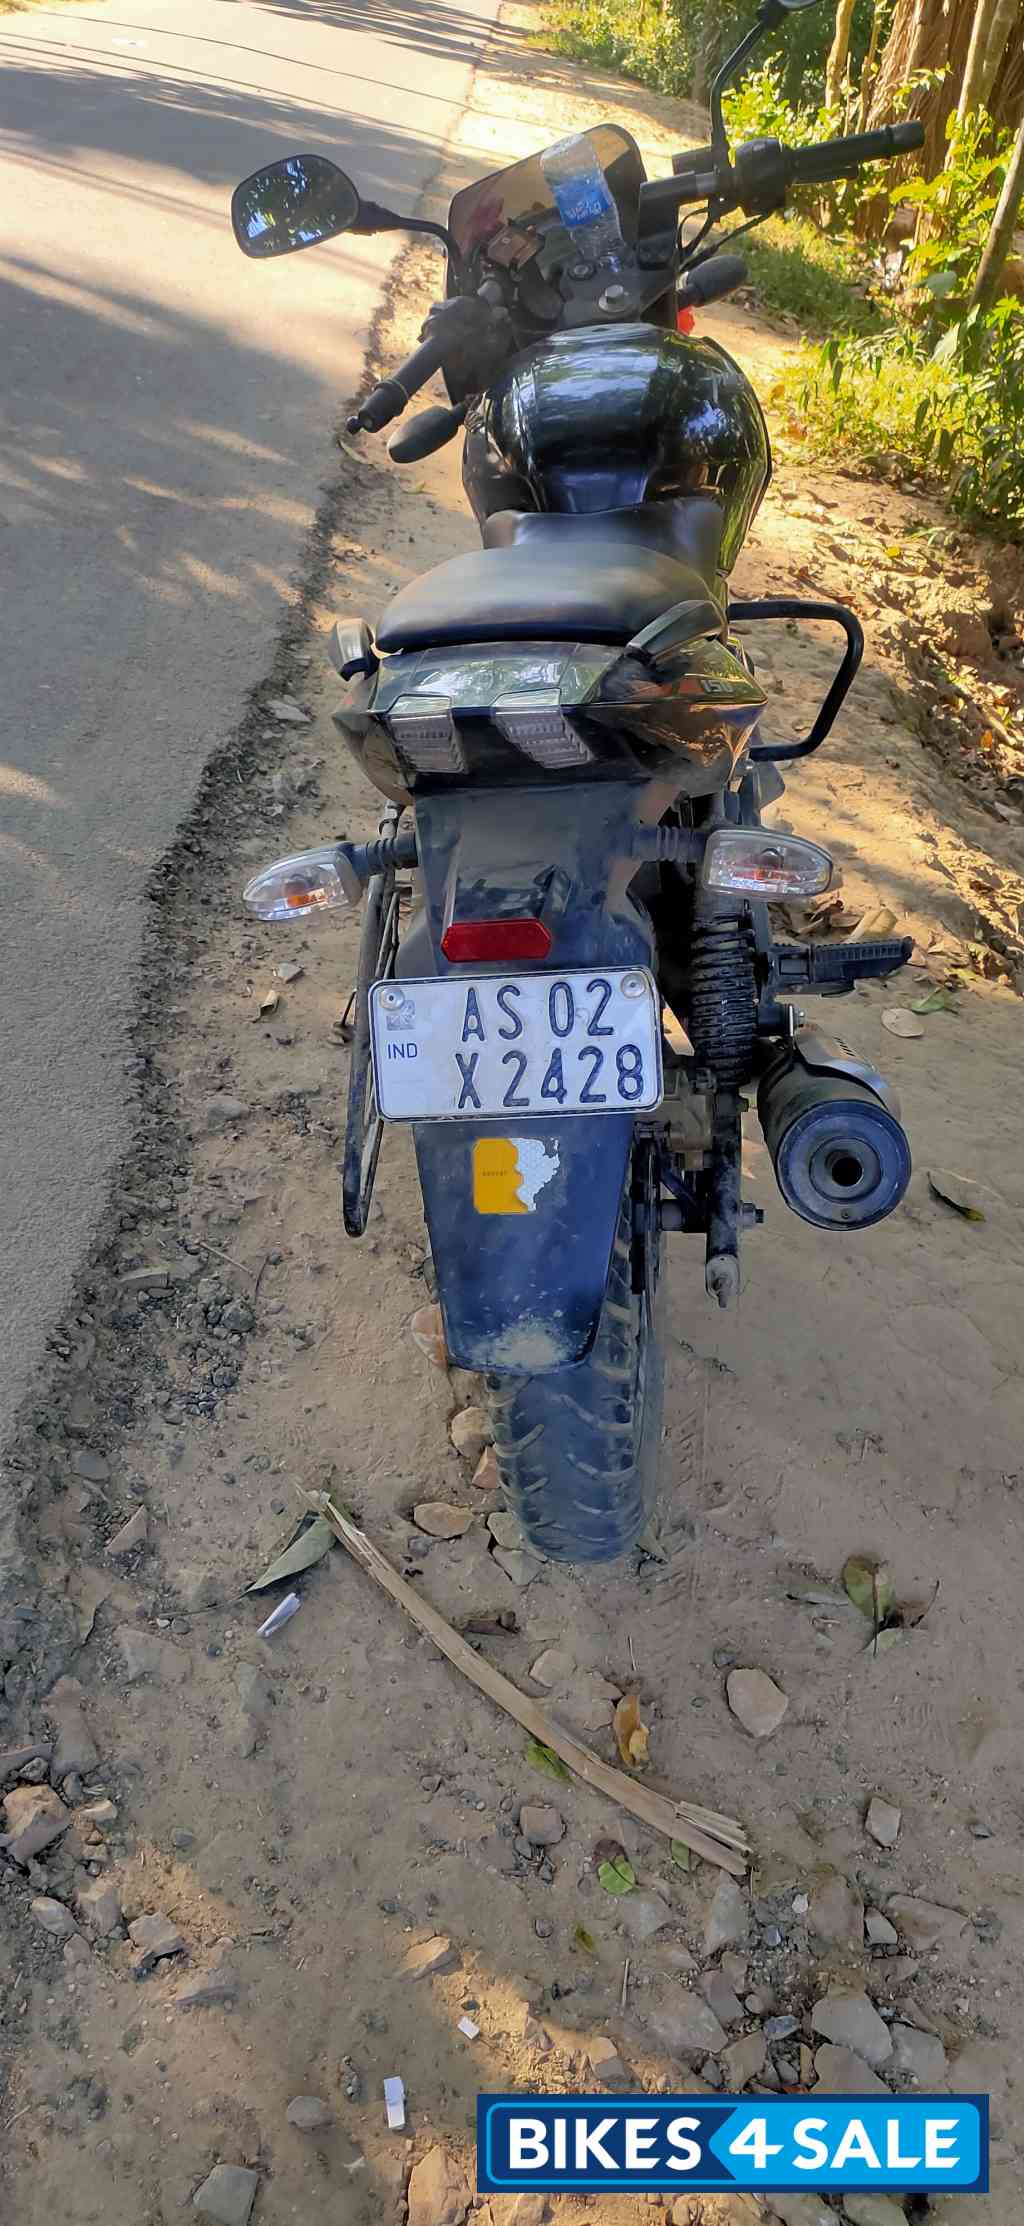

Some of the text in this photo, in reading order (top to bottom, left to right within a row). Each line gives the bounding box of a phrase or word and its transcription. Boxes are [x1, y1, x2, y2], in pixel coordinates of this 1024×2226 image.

[461, 978, 614, 1042] AS 02
[386, 1042, 418, 1059] IND
